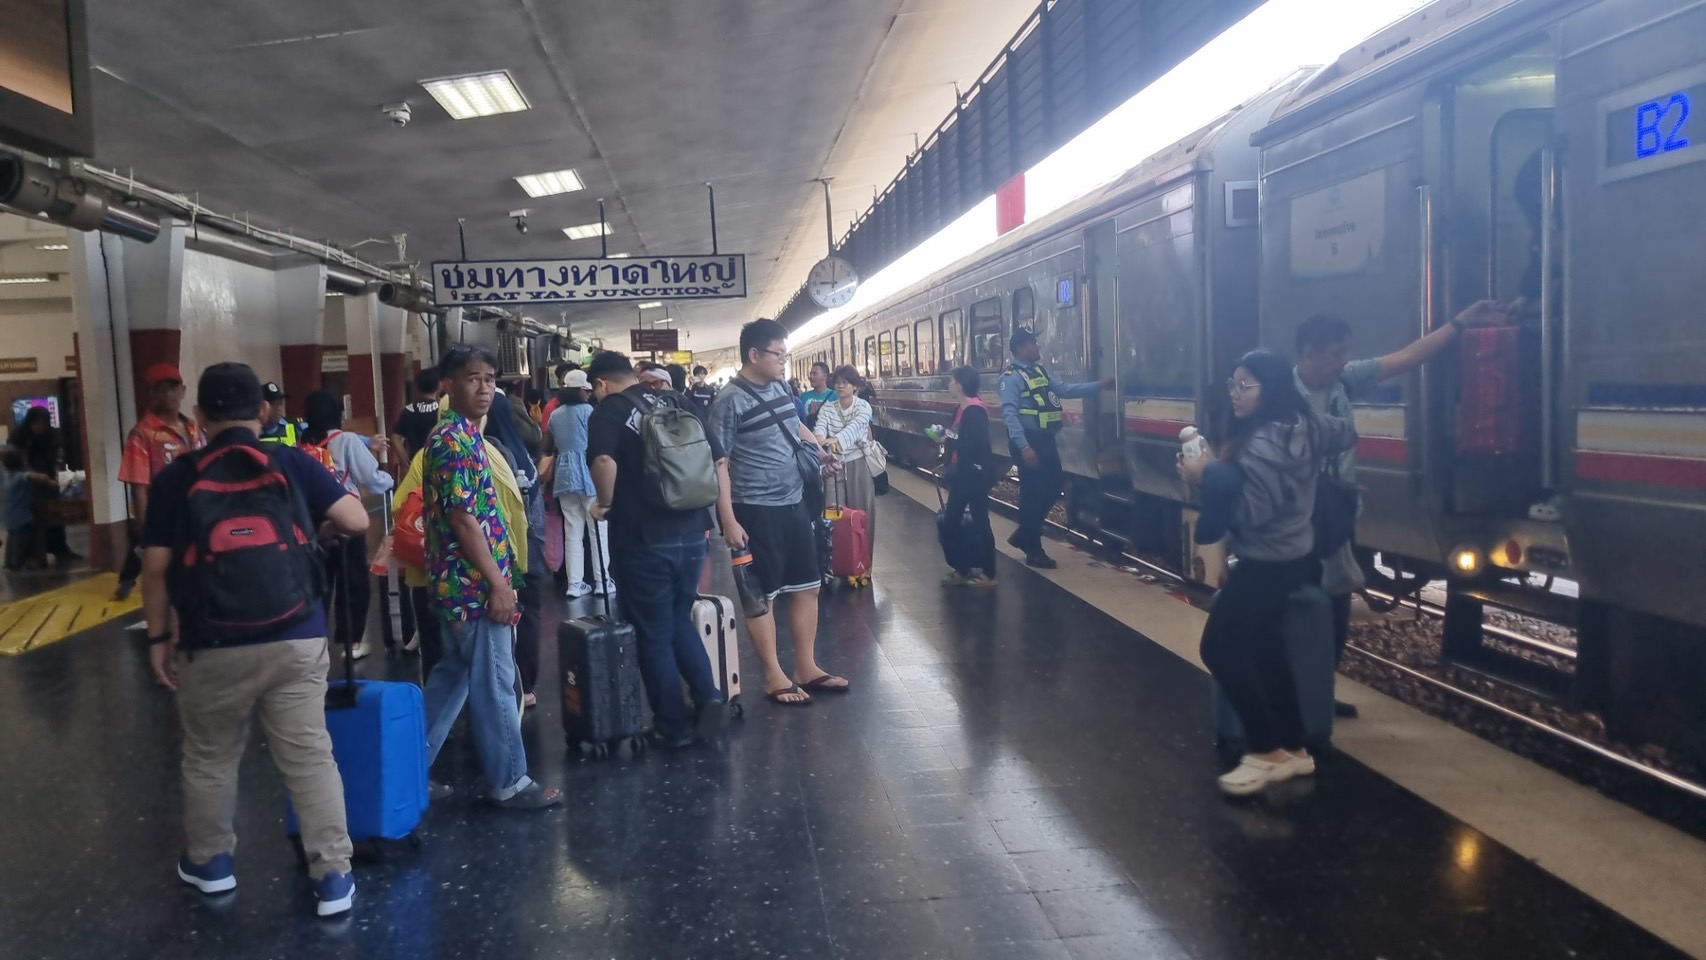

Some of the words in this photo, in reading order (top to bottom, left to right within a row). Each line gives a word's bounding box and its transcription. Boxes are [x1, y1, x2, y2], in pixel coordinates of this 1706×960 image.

[1636, 93, 1689, 159] B2
[441, 257, 736, 300] ชุมทางหาดใหญ่
[461, 291, 521, 302] HAT
[526, 289, 577, 300] YAI
[584, 286, 721, 298] JUNCTION
